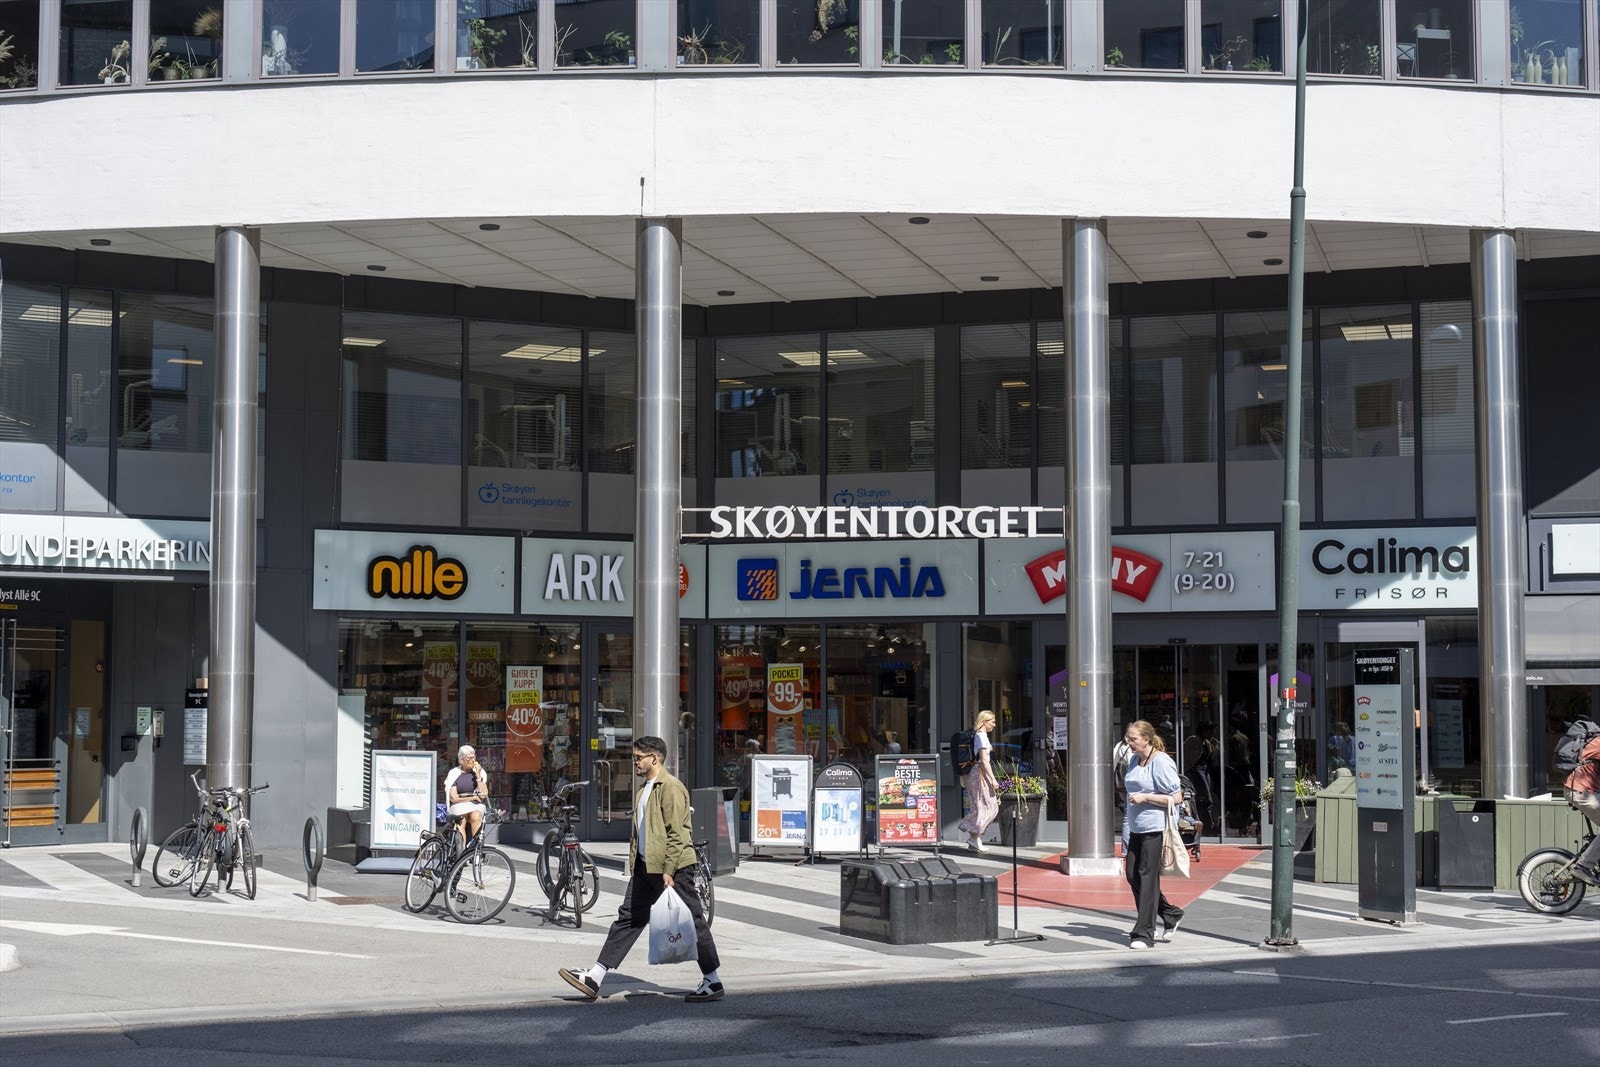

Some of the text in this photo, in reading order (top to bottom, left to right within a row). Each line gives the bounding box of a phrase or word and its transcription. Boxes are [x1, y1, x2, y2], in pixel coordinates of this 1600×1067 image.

[502, 483, 536, 494] Skøyen
[857, 488, 891, 498] Skøyen
[503, 496, 573, 508] tannlegekontor
[710, 504, 1043, 539] SKØYENTORGET
[1184, 552, 1224, 568] 7-21
[1312, 537, 1470, 575] Calima
[371, 548, 465, 597] nille
[544, 553, 625, 601] ARK
[1174, 573, 1235, 594] (9-20)
[15, 589, 31, 601] Allé
[31, 590, 41, 602] 9C
[1335, 588, 1448, 599] FRISØR
[466, 662, 498, 678] -40%
[511, 669, 539, 678] GJØR ET
[771, 668, 800, 679] POCKET
[513, 679, 536, 688] KUPP!
[507, 708, 540, 725] -40%
[825, 768, 853, 776] Calima
[894, 769, 921, 779] BESTE
[917, 803, 935, 812] 50%
[384, 822, 421, 833] INNGANG
[758, 827, 779, 838] 20%
